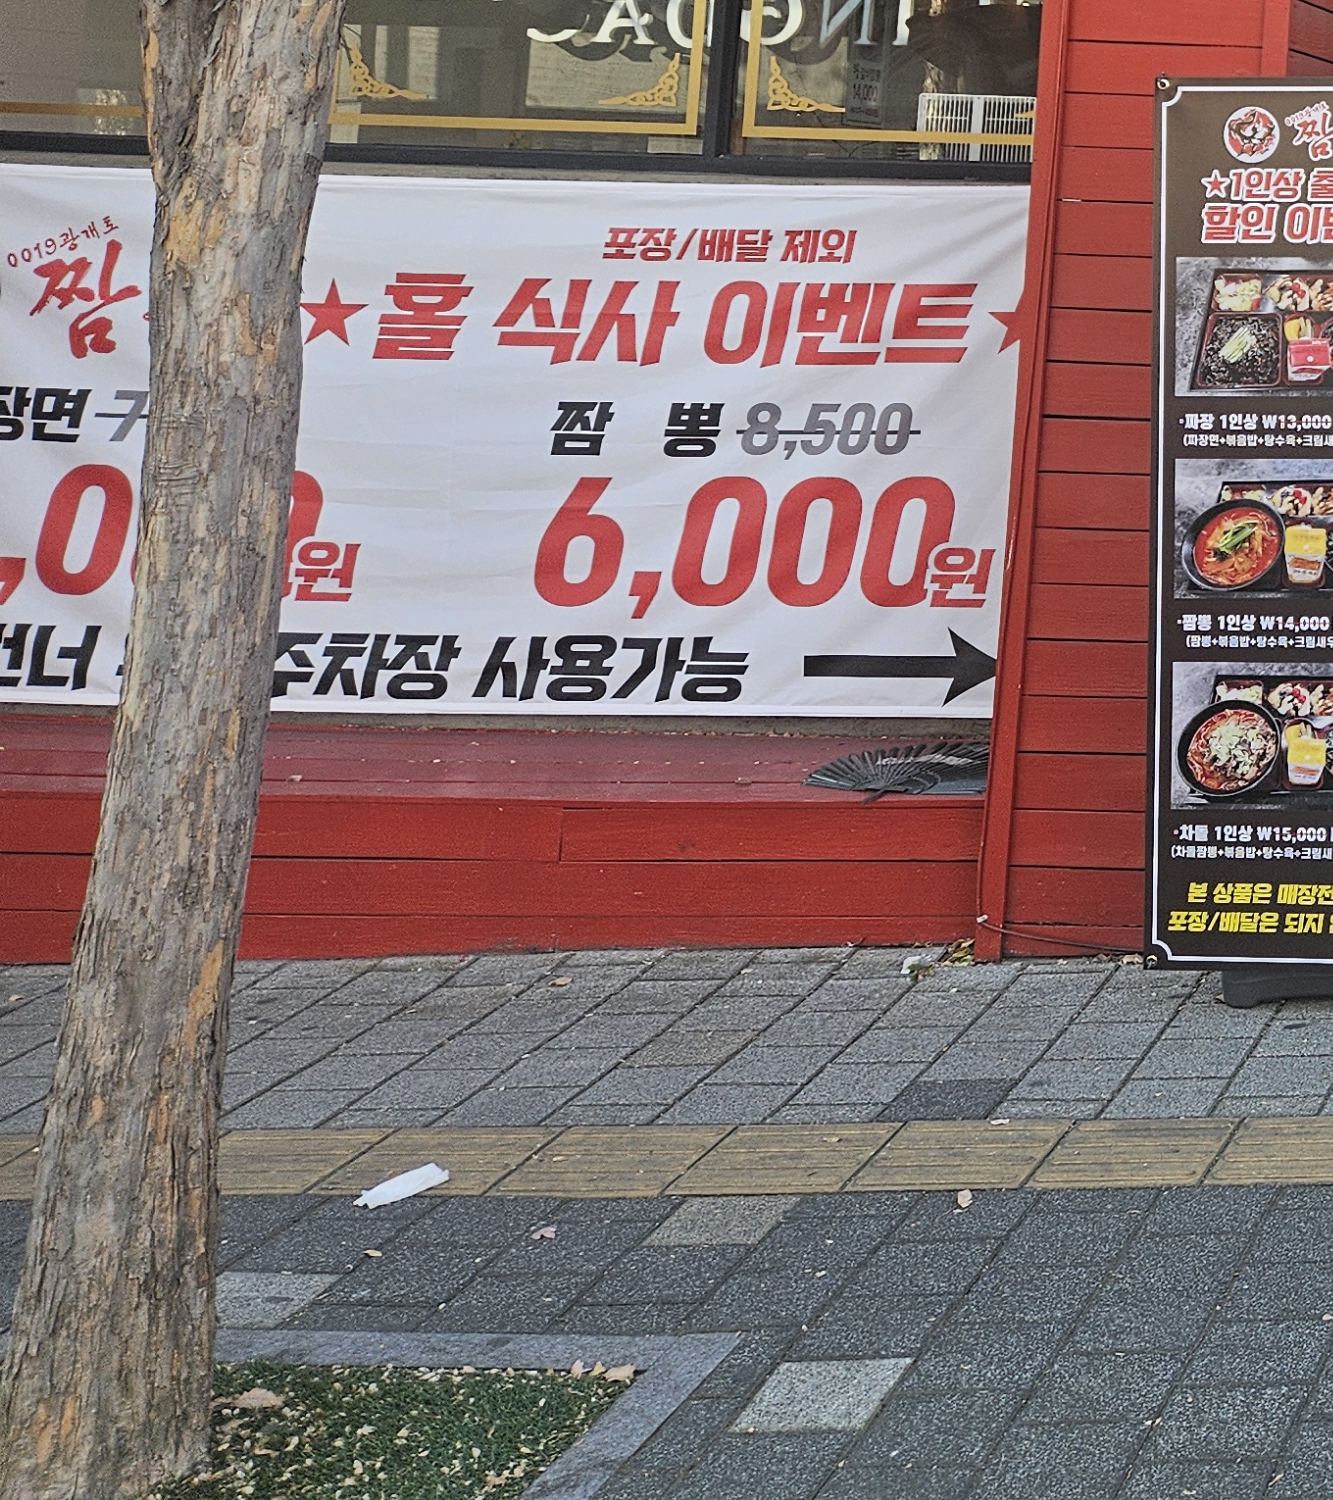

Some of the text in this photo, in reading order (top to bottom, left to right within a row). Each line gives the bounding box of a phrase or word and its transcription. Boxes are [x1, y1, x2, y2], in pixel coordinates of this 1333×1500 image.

[1229, 169, 1304, 200] 1인상
[1201, 204, 1277, 243] 할인
[603, 226, 857, 266] 포장/배달 제외
[372, 271, 977, 369] 홀 식사 이벤트
[738, 401, 915, 461] 8,500
[1220, 414, 1257, 431] 1인상
[1182, 615, 1212, 632] 짬뽕
[1217, 615, 1257, 632] 1인상
[475, 633, 750, 703] 사용가능
[1214, 825, 1252, 841] 1인상
[1187, 882, 1207, 903] 본
[1212, 882, 1272, 904] 상품은
[1168, 910, 1279, 933] 포장/배달은
[1285, 913, 1324, 934] 되지
